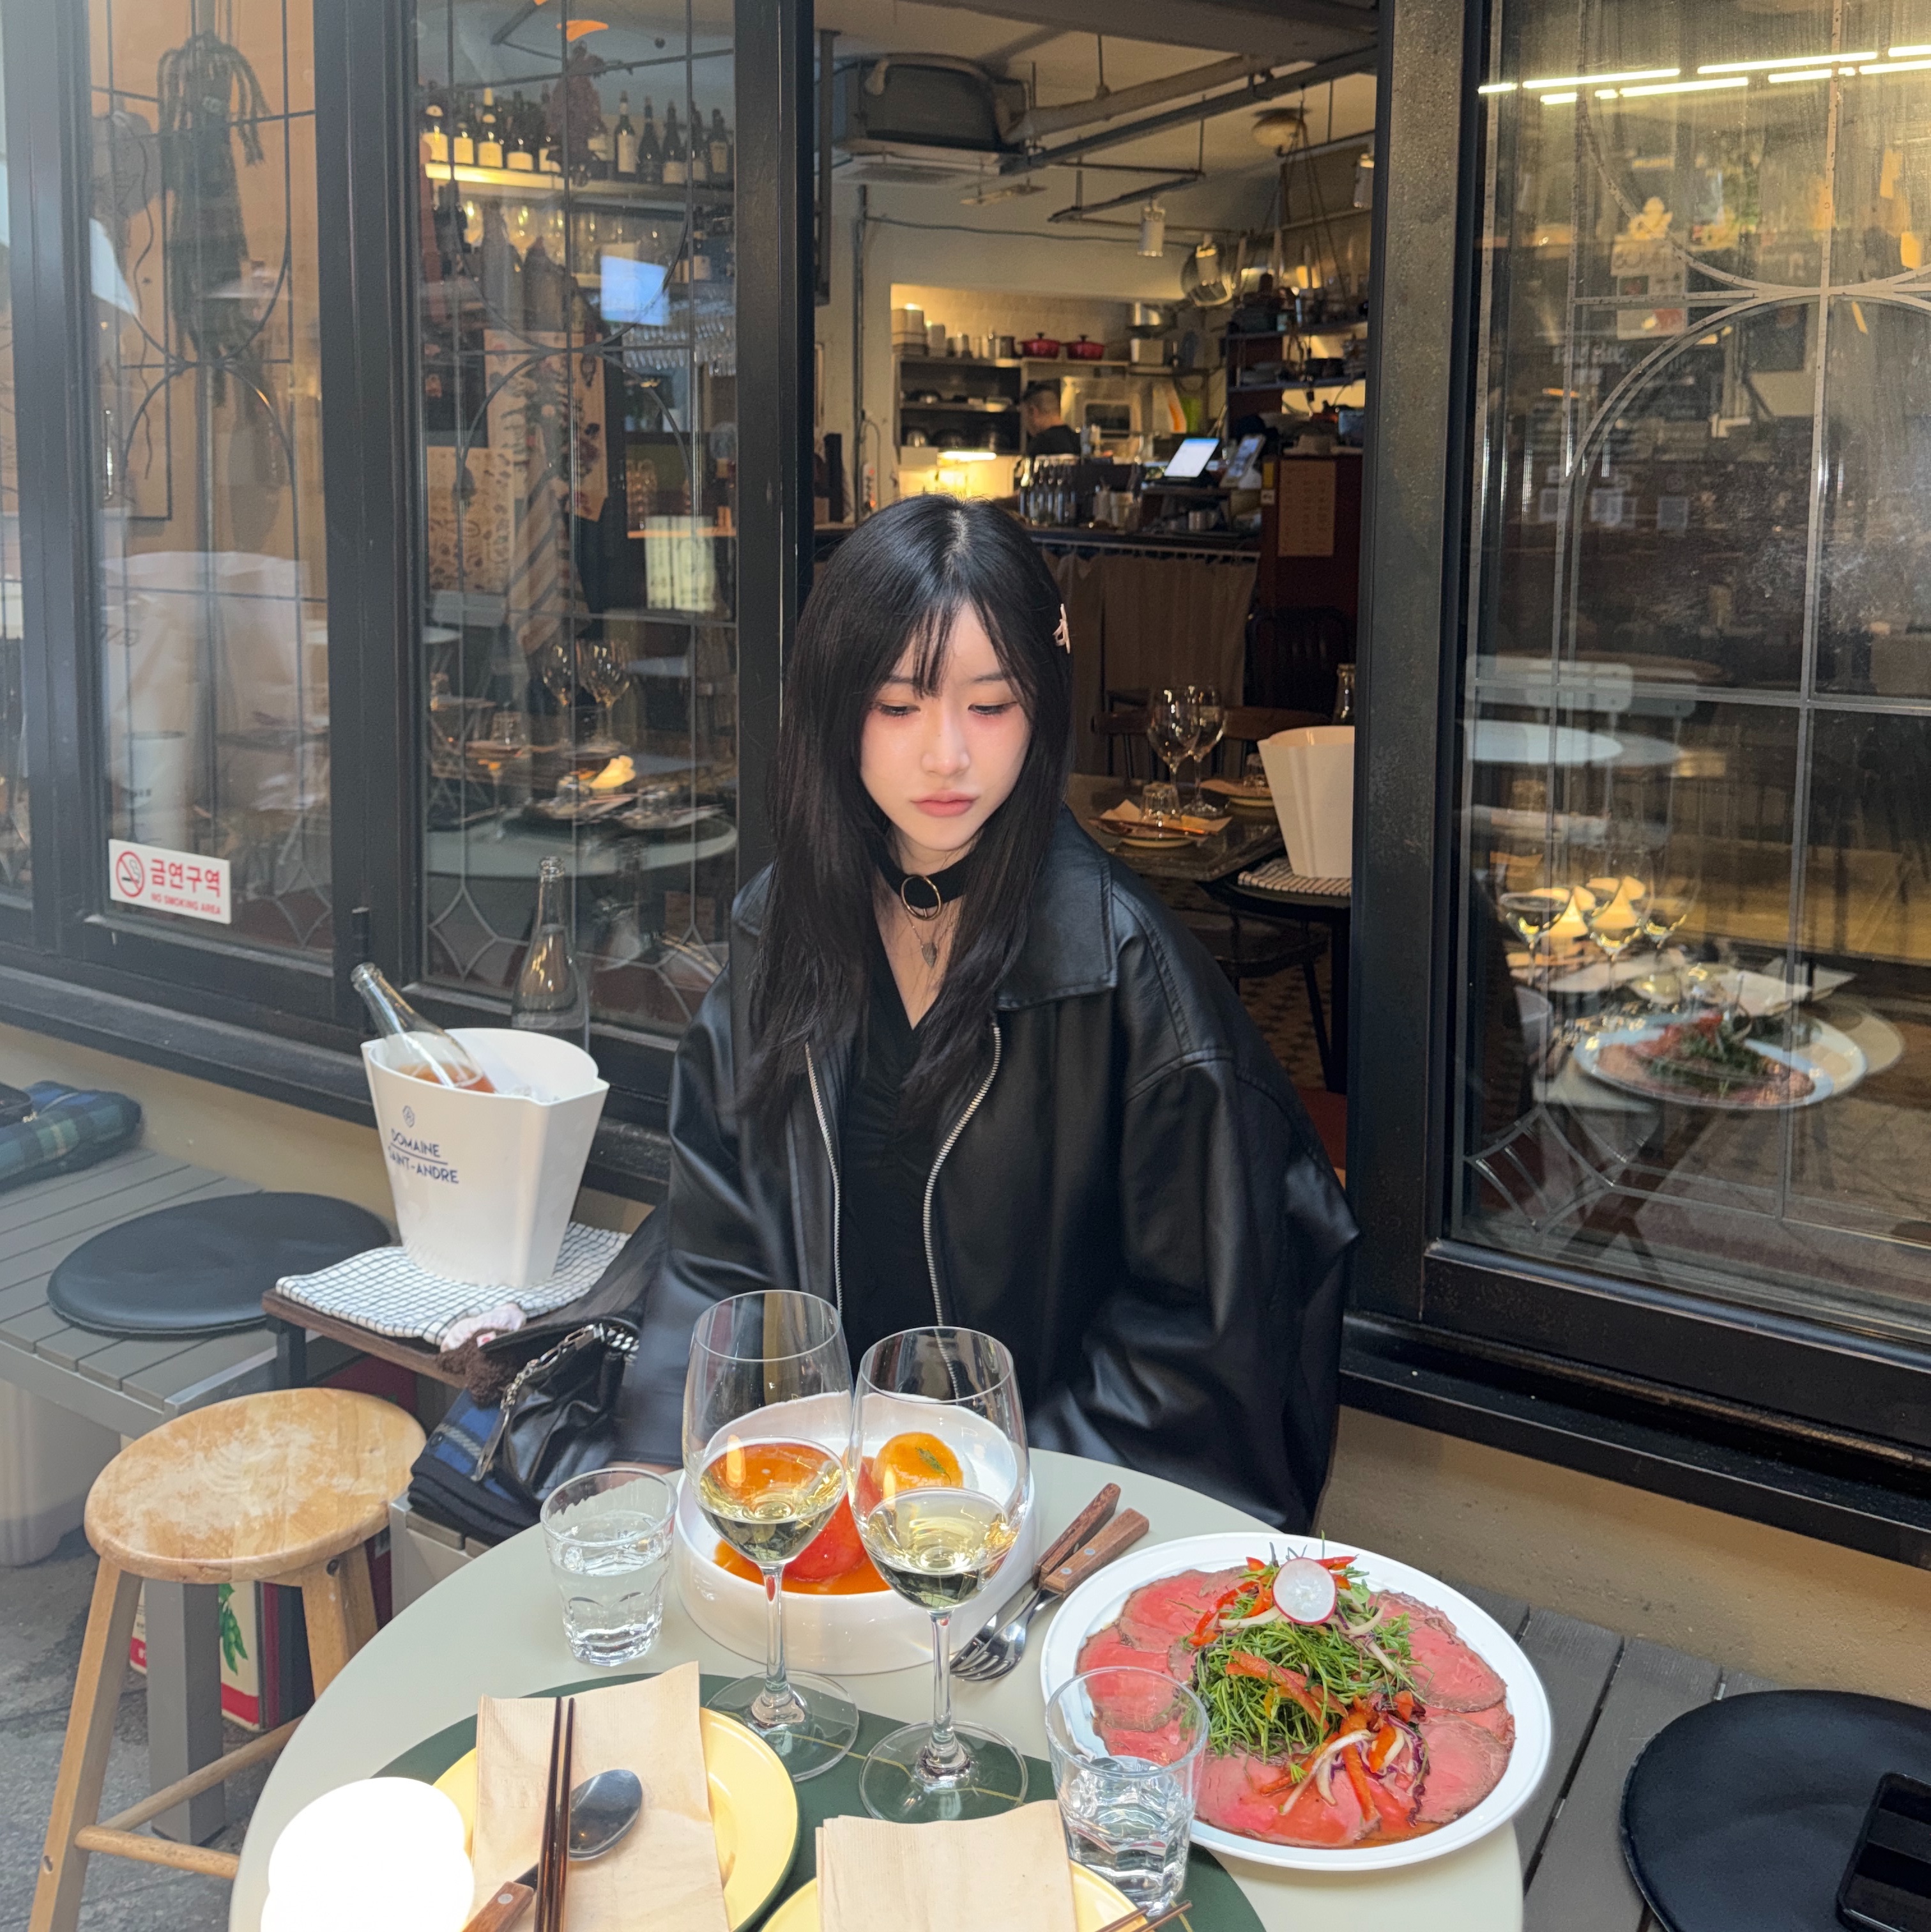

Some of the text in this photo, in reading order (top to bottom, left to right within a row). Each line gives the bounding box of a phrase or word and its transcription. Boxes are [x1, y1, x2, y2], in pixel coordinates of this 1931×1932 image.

[151, 859, 220, 897] 금연구역
[151, 893, 220, 914] NO SMOKING AREA
[391, 1128, 441, 1158] DOMAINE
